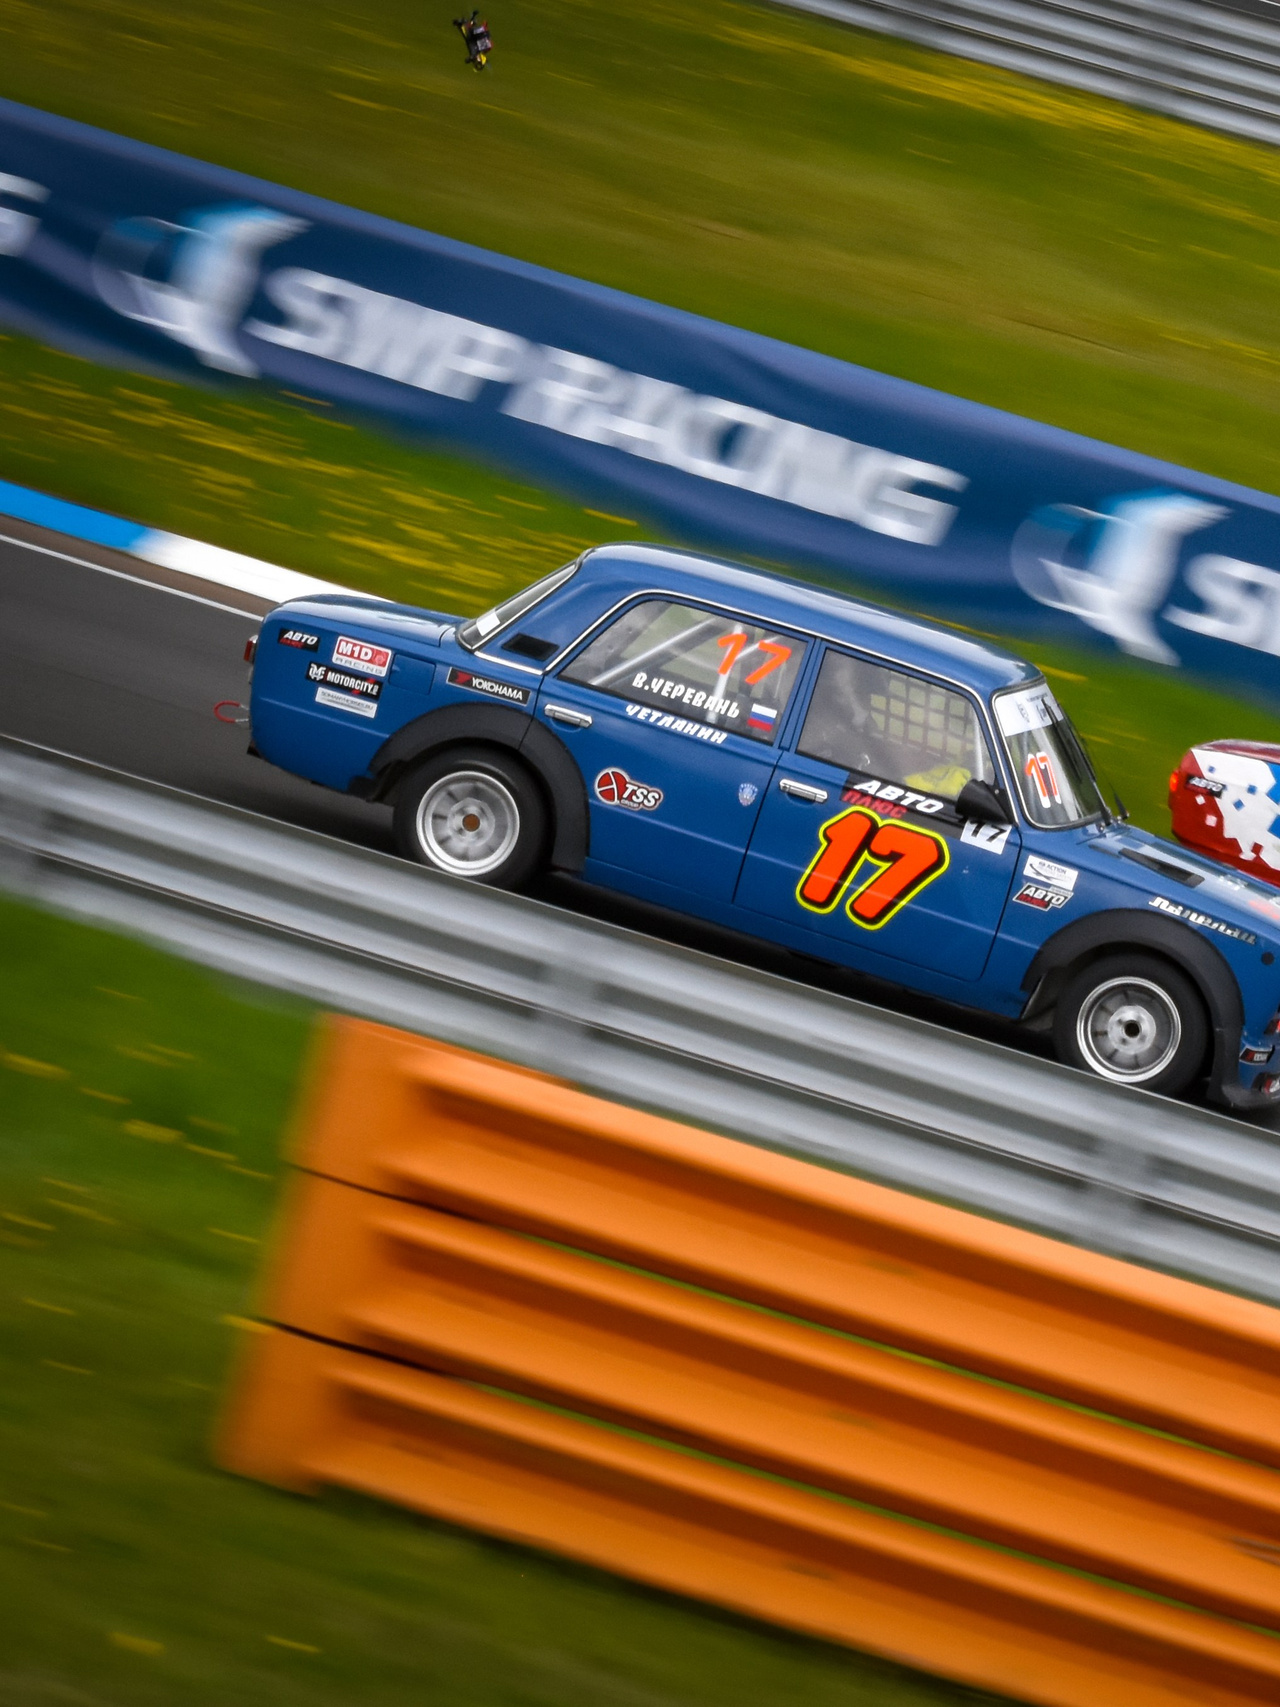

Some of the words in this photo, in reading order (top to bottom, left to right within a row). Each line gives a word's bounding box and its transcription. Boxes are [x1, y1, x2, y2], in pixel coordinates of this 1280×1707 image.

[284, 630, 318, 646] АВТО
[338, 641, 373, 661] M1D
[335, 657, 384, 676] RACING
[717, 633, 792, 685] 17
[471, 676, 523, 701] YOKOHAMA
[625, 704, 728, 745] ЧЕТЛАНИН
[1024, 751, 1062, 809] 17
[622, 783, 660, 807] TSS
[841, 789, 909, 819] ПЛЮС
[853, 779, 945, 814] АВТО
[796, 805, 950, 931] 17
[1022, 886, 1066, 905] АВТО
